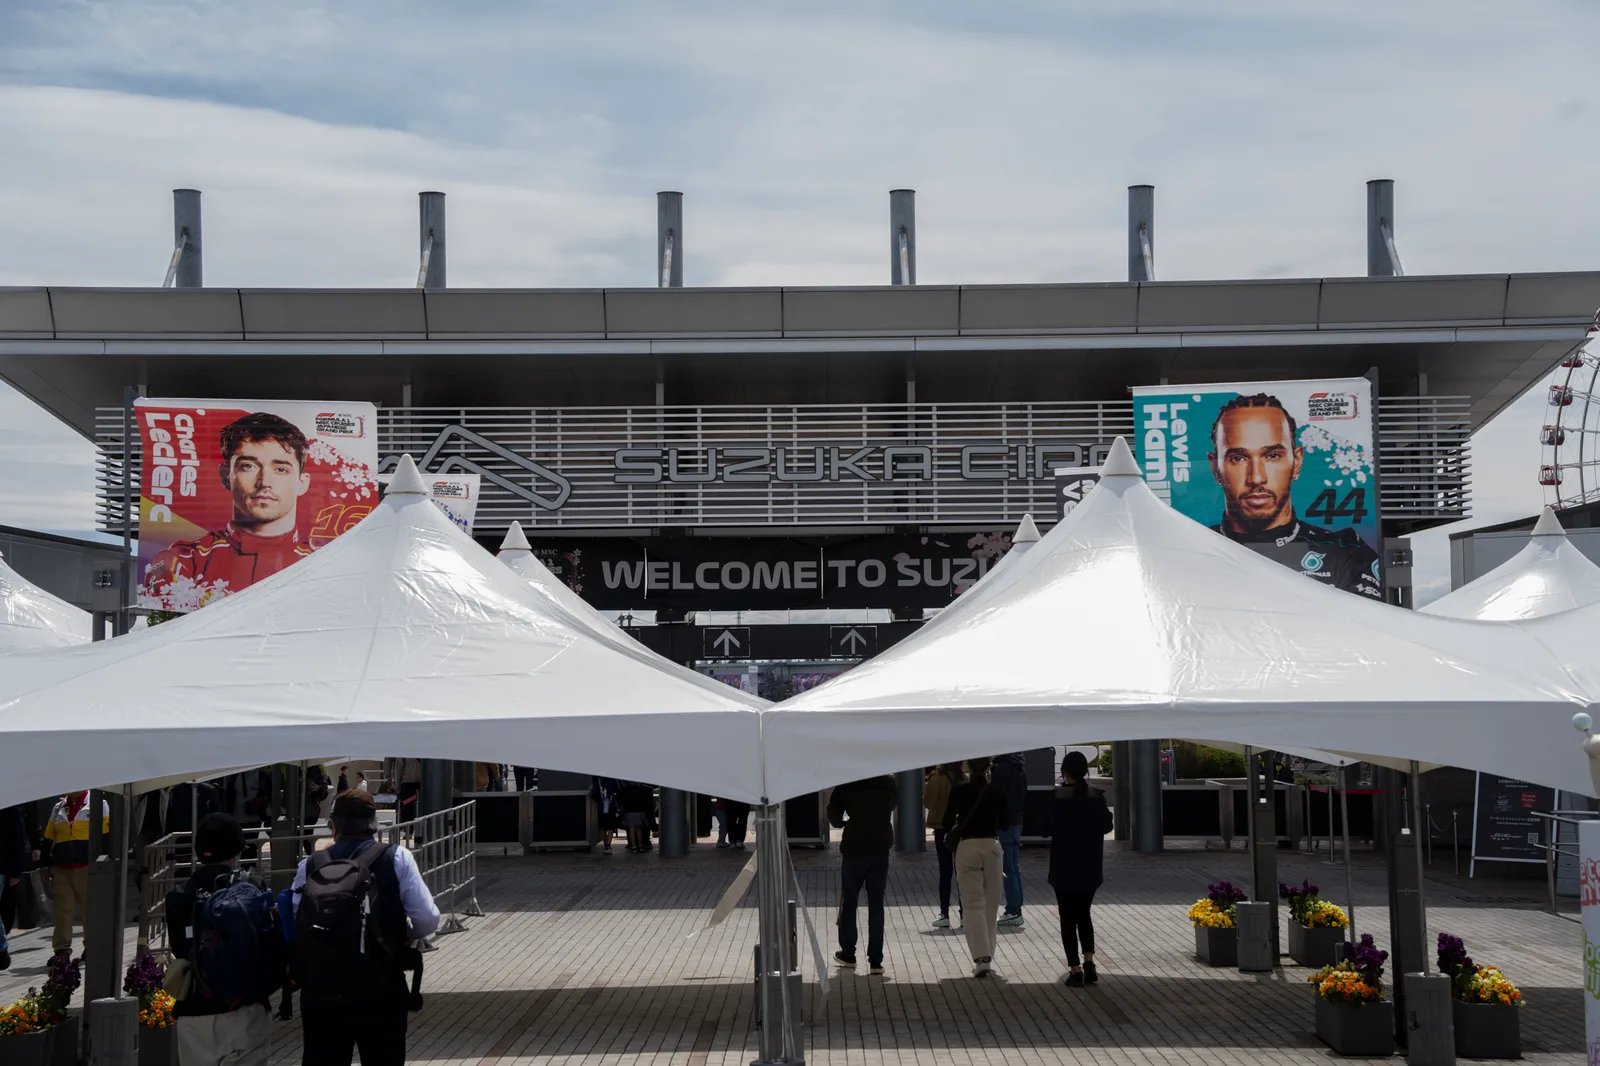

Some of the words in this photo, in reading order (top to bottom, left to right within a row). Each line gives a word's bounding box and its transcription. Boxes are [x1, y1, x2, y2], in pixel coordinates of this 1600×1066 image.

[174, 414, 200, 496] Charles
[1170, 403, 1191, 482] Lewis
[144, 412, 178, 522] Leclerc
[614, 446, 933, 482] SUZUKA
[1062, 480, 1081, 517] Ve
[1305, 488, 1368, 525] 44
[310, 504, 373, 538] 16
[601, 561, 817, 590] WELCOME
[828, 559, 887, 588] TO
